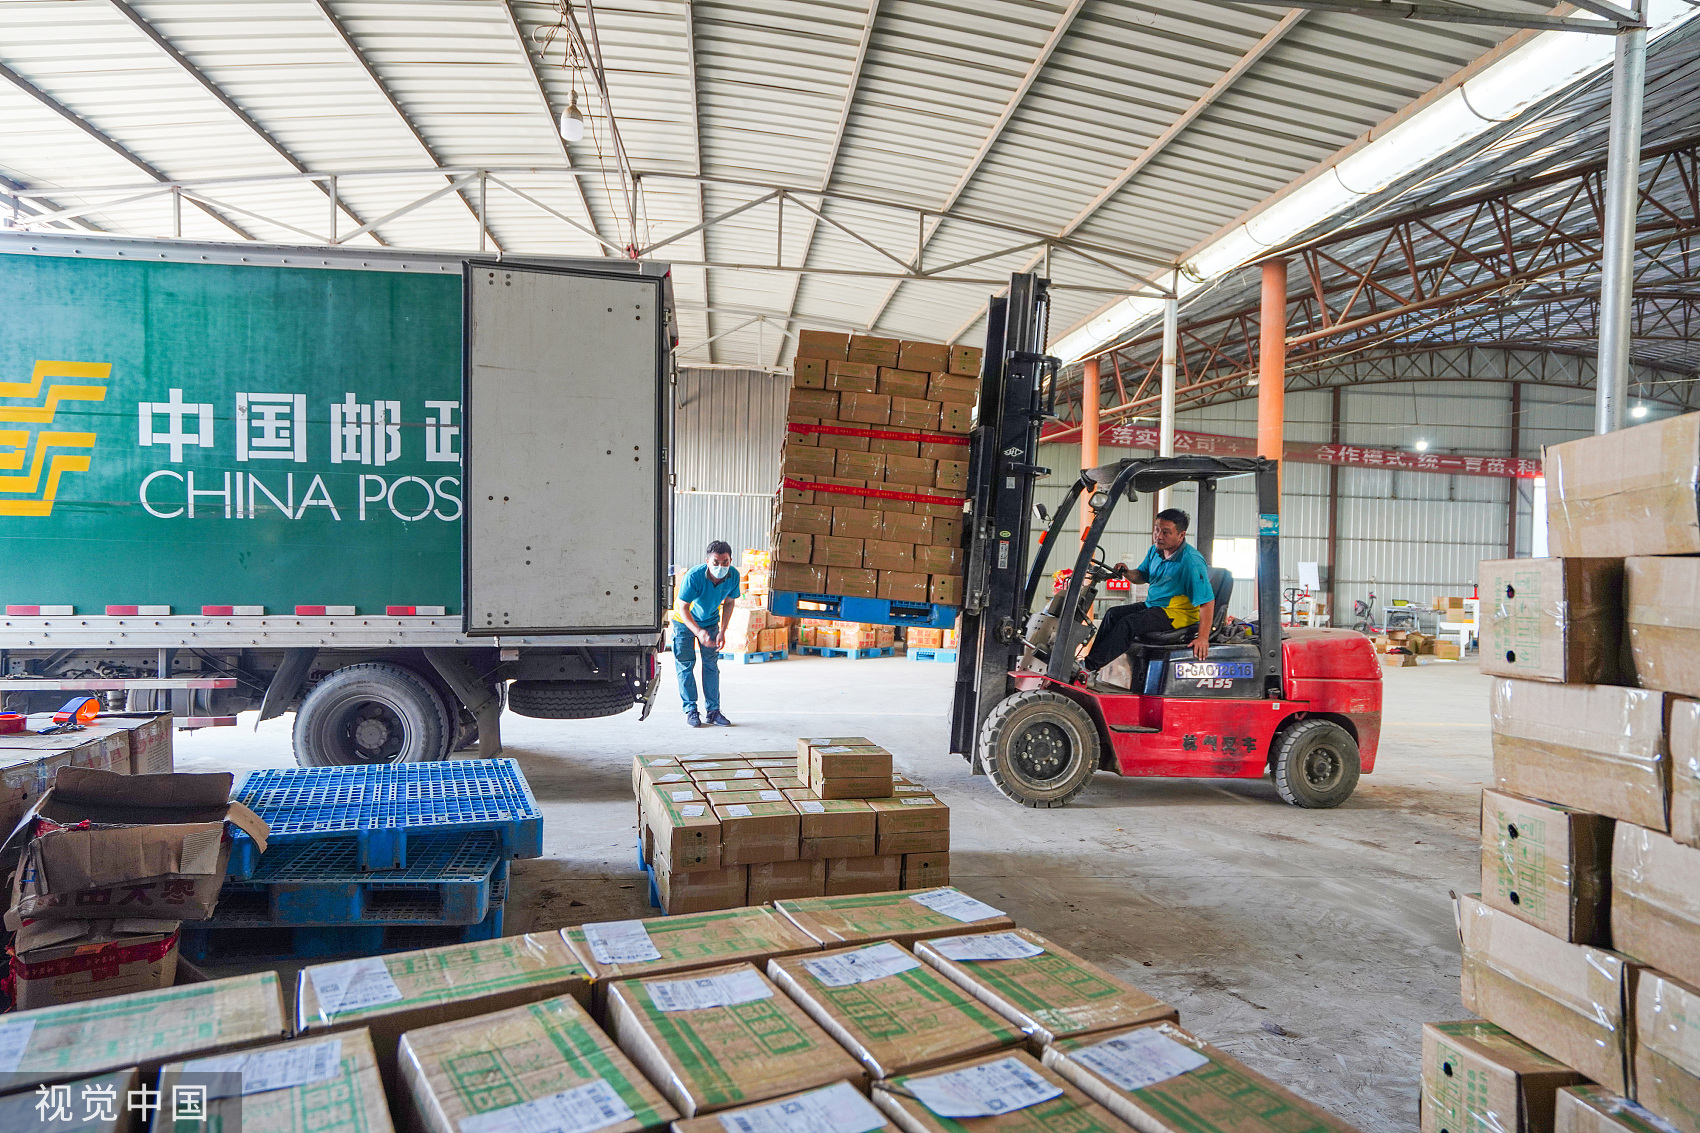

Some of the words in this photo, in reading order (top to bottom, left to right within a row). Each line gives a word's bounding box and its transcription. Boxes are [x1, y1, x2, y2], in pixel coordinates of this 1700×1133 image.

[1316, 445, 1545, 476] 合作模式,统一育苗、科
[139, 470, 341, 521] CHINA
